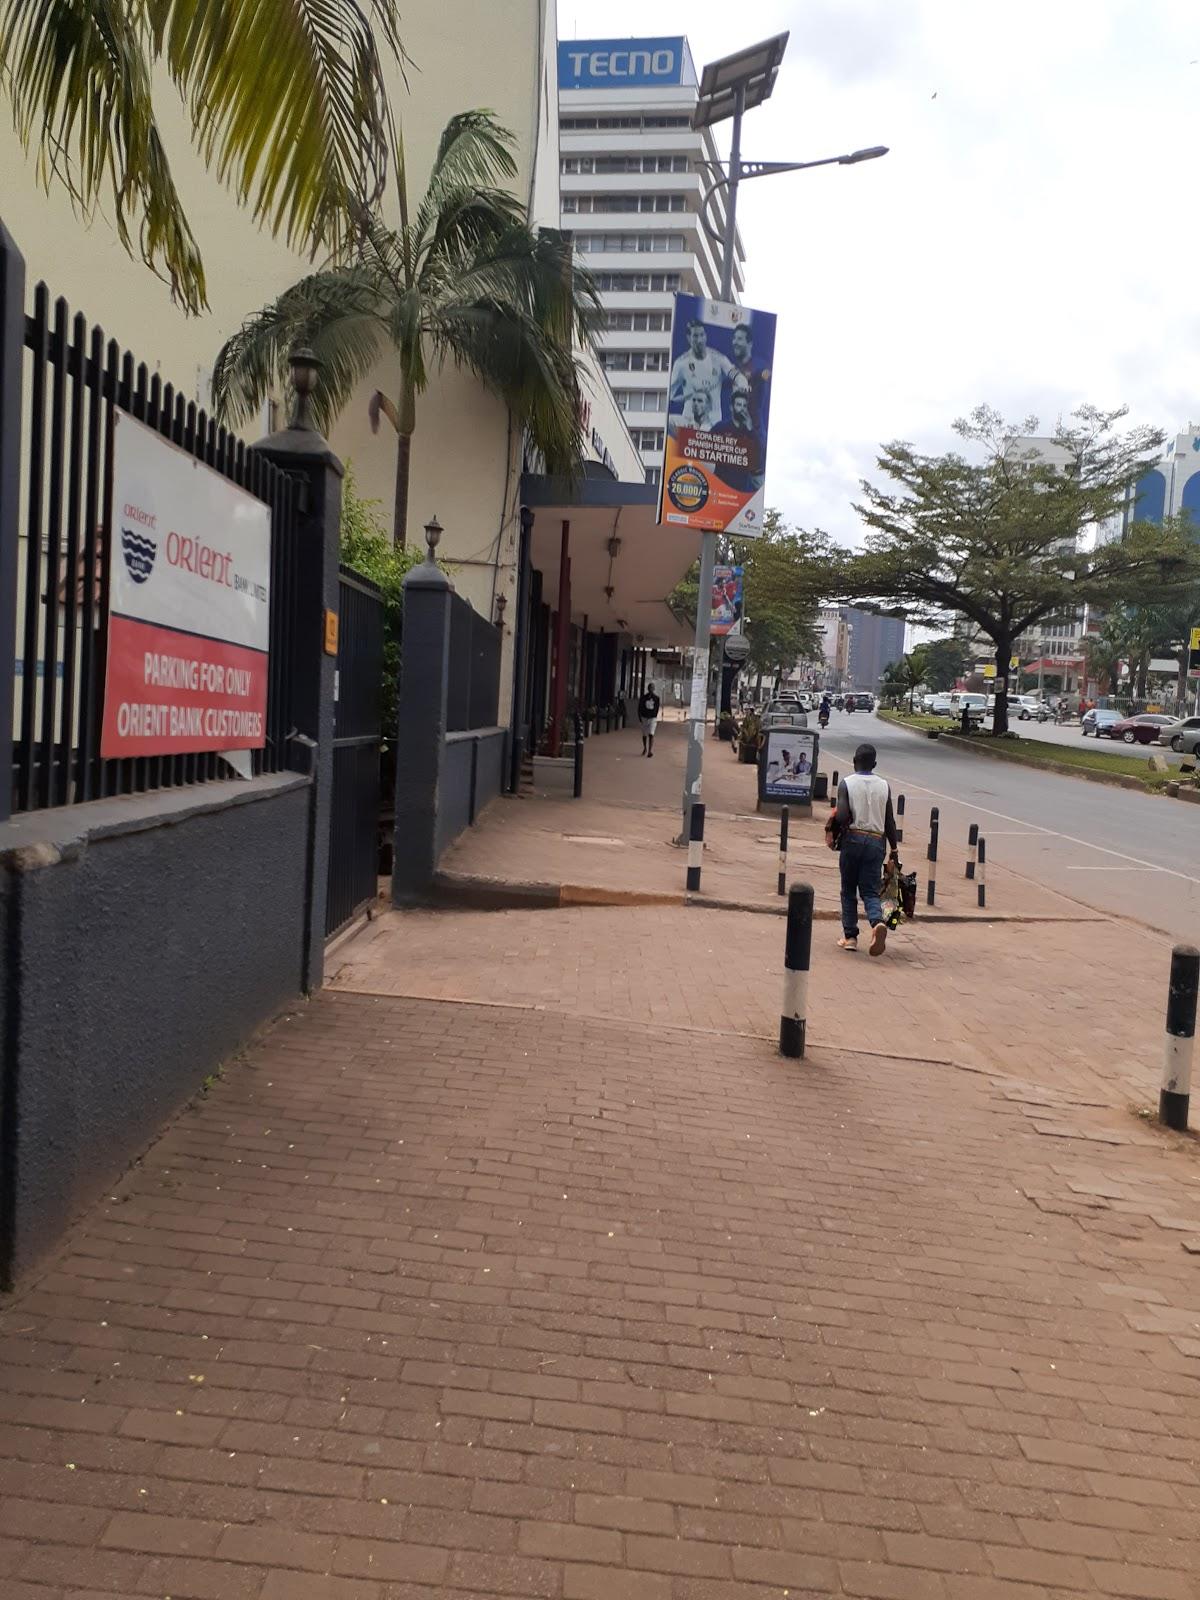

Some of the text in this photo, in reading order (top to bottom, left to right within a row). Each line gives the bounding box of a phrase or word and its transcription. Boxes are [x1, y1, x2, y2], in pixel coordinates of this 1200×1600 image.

[568, 50, 675, 77] TECNO
[688, 439, 748, 456] SPANISH SUPER CUP
[695, 432, 738, 446] COPA DEL REY
[684, 447, 749, 467] ON STARTIMES
[144, 652, 251, 696] PARKING FOR ONLY
[117, 702, 262, 737] ORIENT BANK CUSTOMERS
